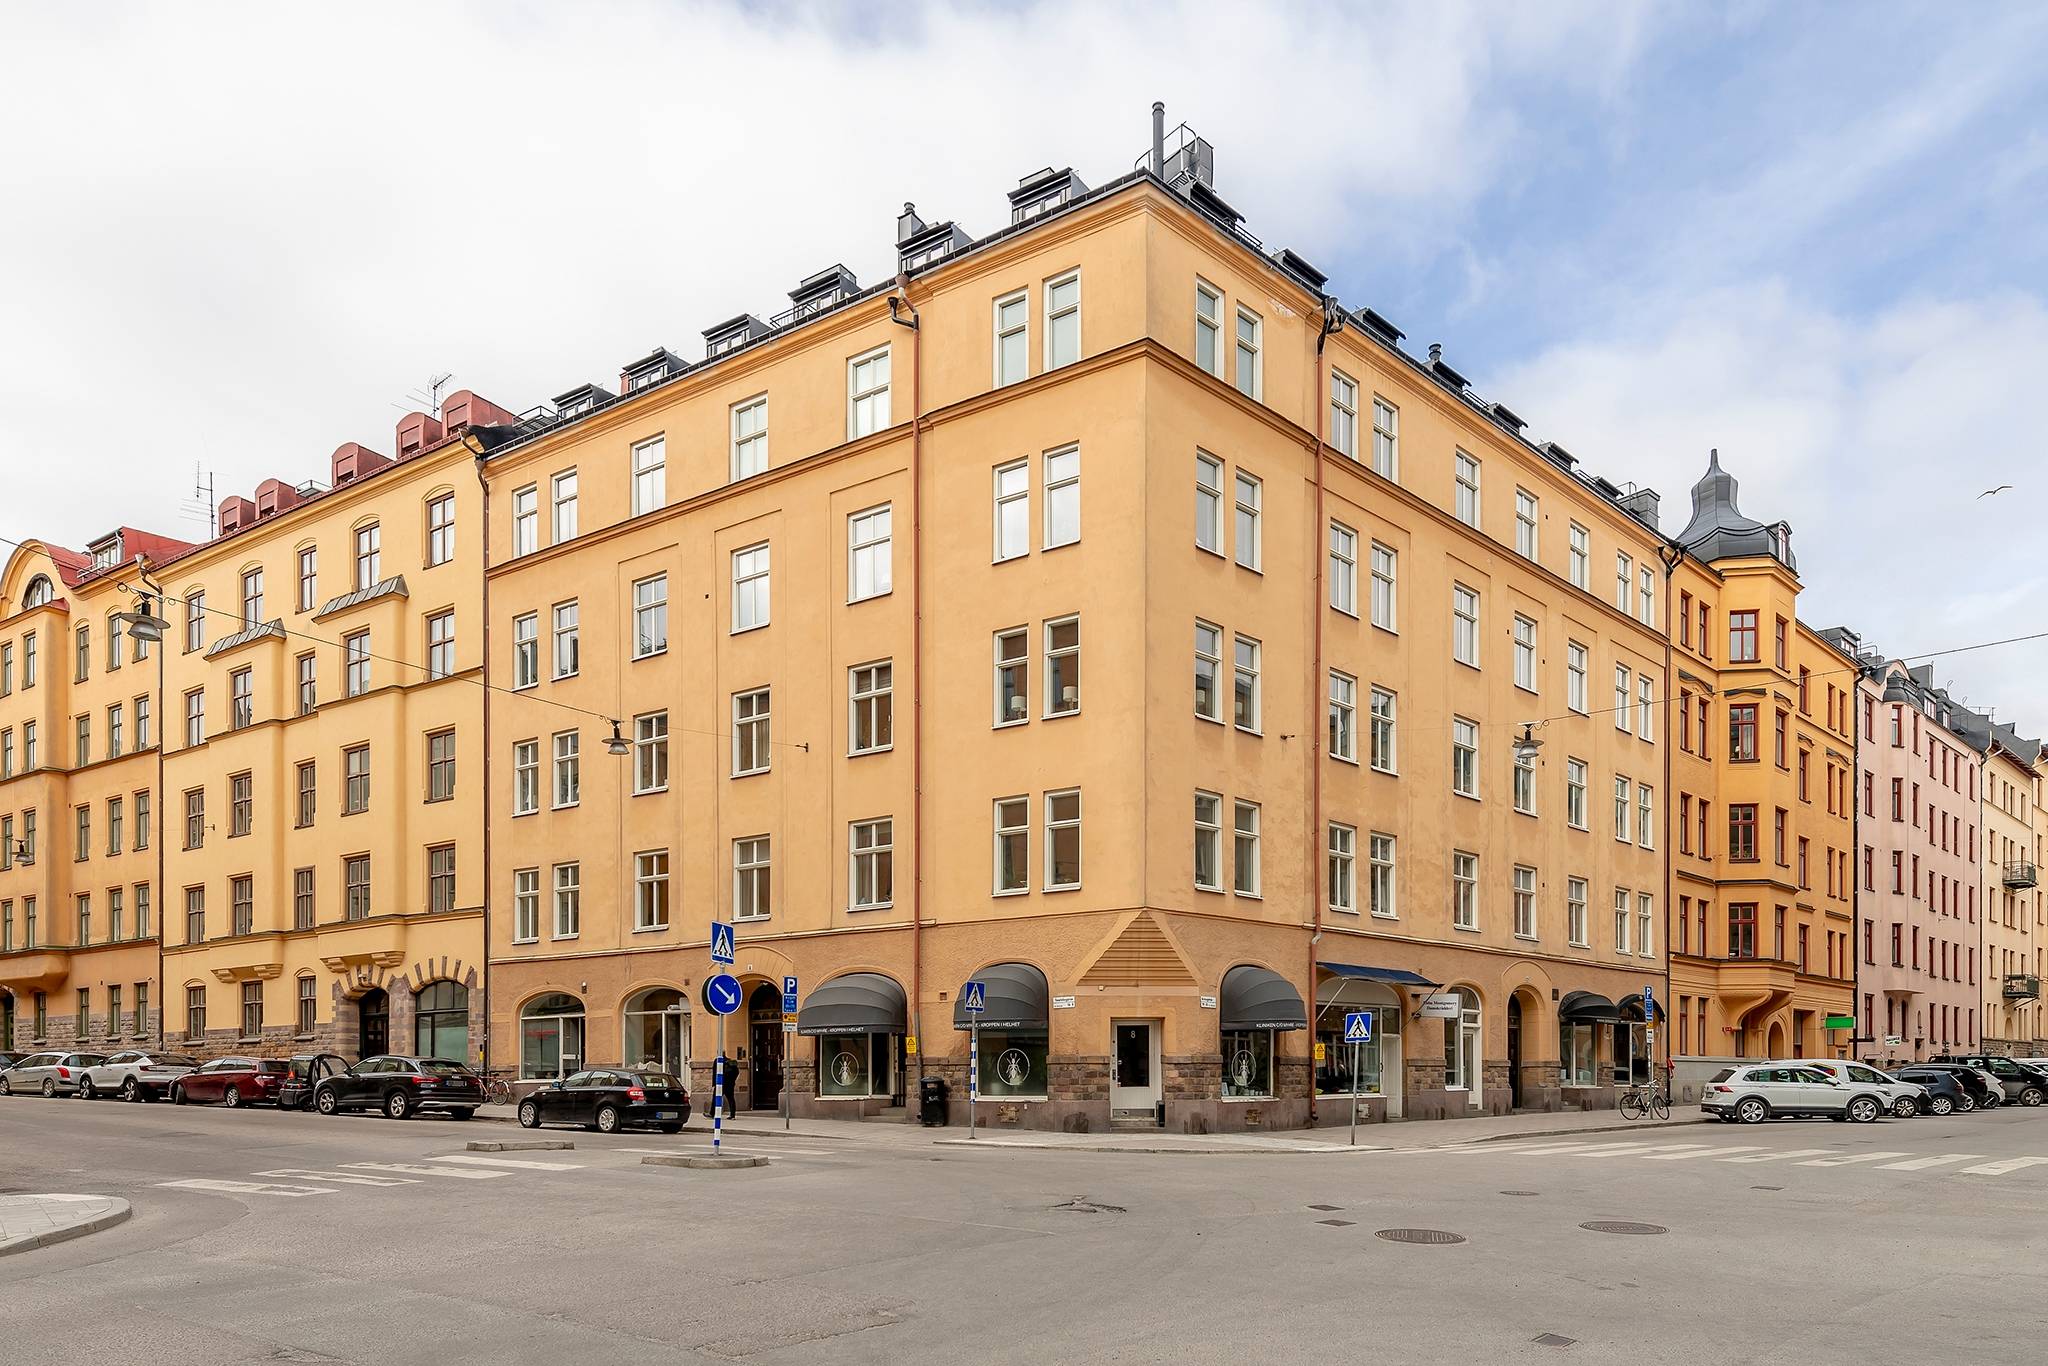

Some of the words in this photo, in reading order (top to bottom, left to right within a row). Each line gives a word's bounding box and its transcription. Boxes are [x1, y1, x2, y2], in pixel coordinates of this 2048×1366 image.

[787, 978, 796, 993] P
[1646, 987, 1652, 999] P
[1130, 1030, 1136, 1039] 8
